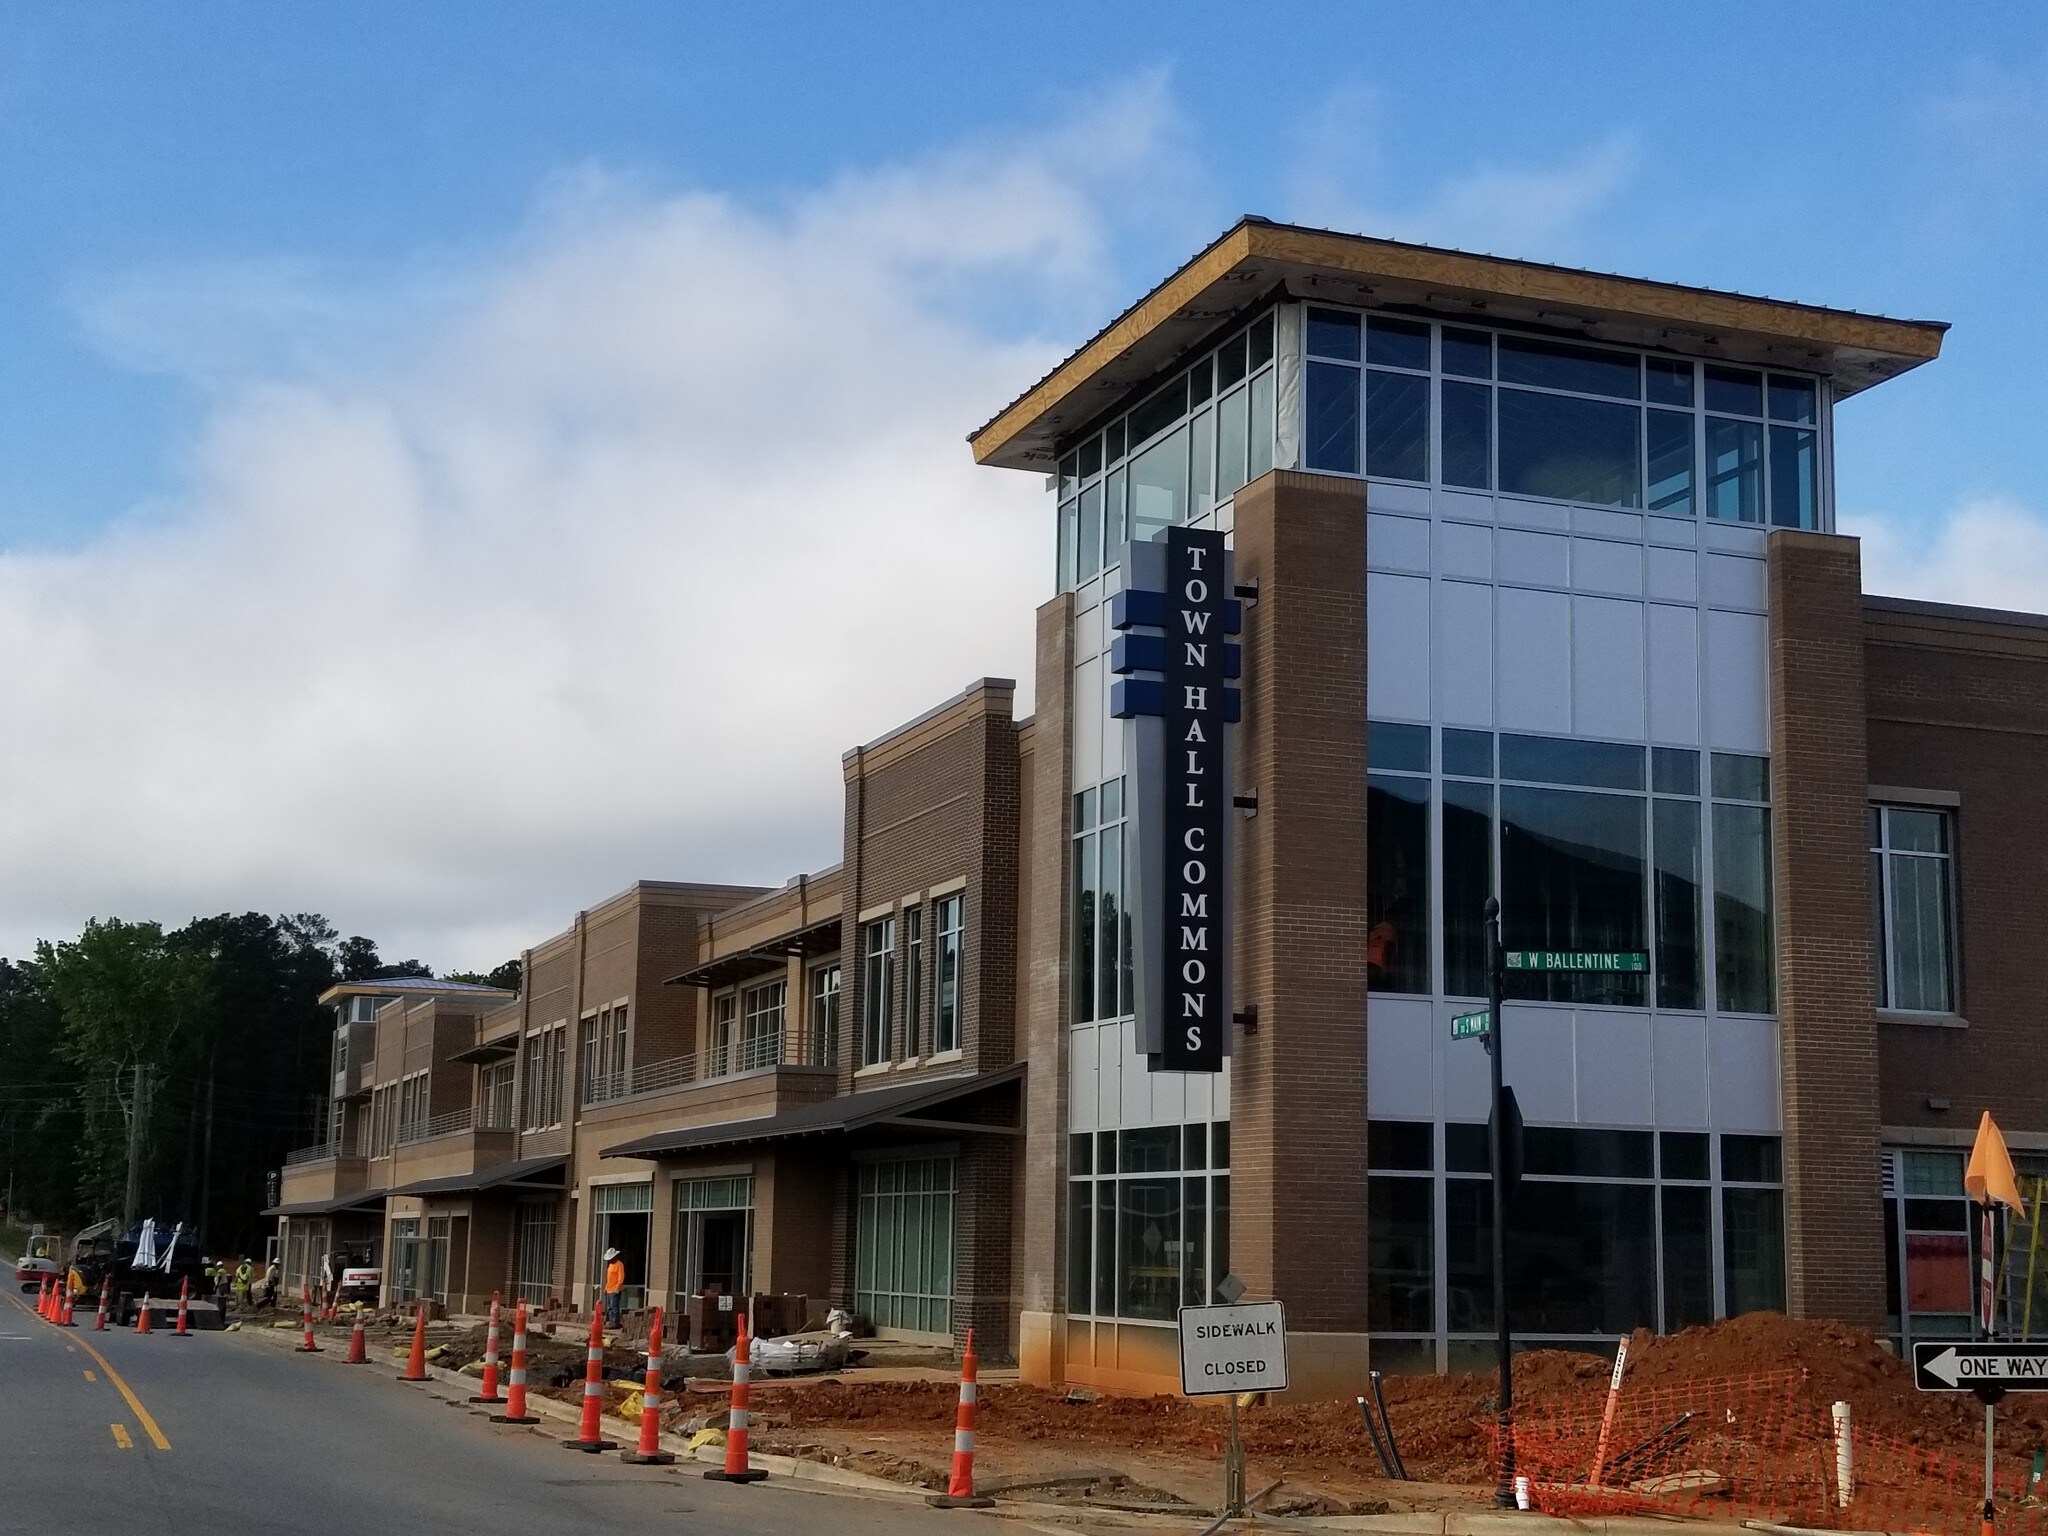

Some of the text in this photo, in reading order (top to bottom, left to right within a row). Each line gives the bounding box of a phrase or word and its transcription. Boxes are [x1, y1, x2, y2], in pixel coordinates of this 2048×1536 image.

[1180, 546, 1210, 1050] TOWN HALL COMMONS
[1529, 953, 1640, 969] W BALLENTINE ST
[1197, 1322, 1275, 1338] SIDEWALK
[1204, 1360, 1266, 1376] CLOSED
[1960, 1358, 2048, 1376] ONE WAY
